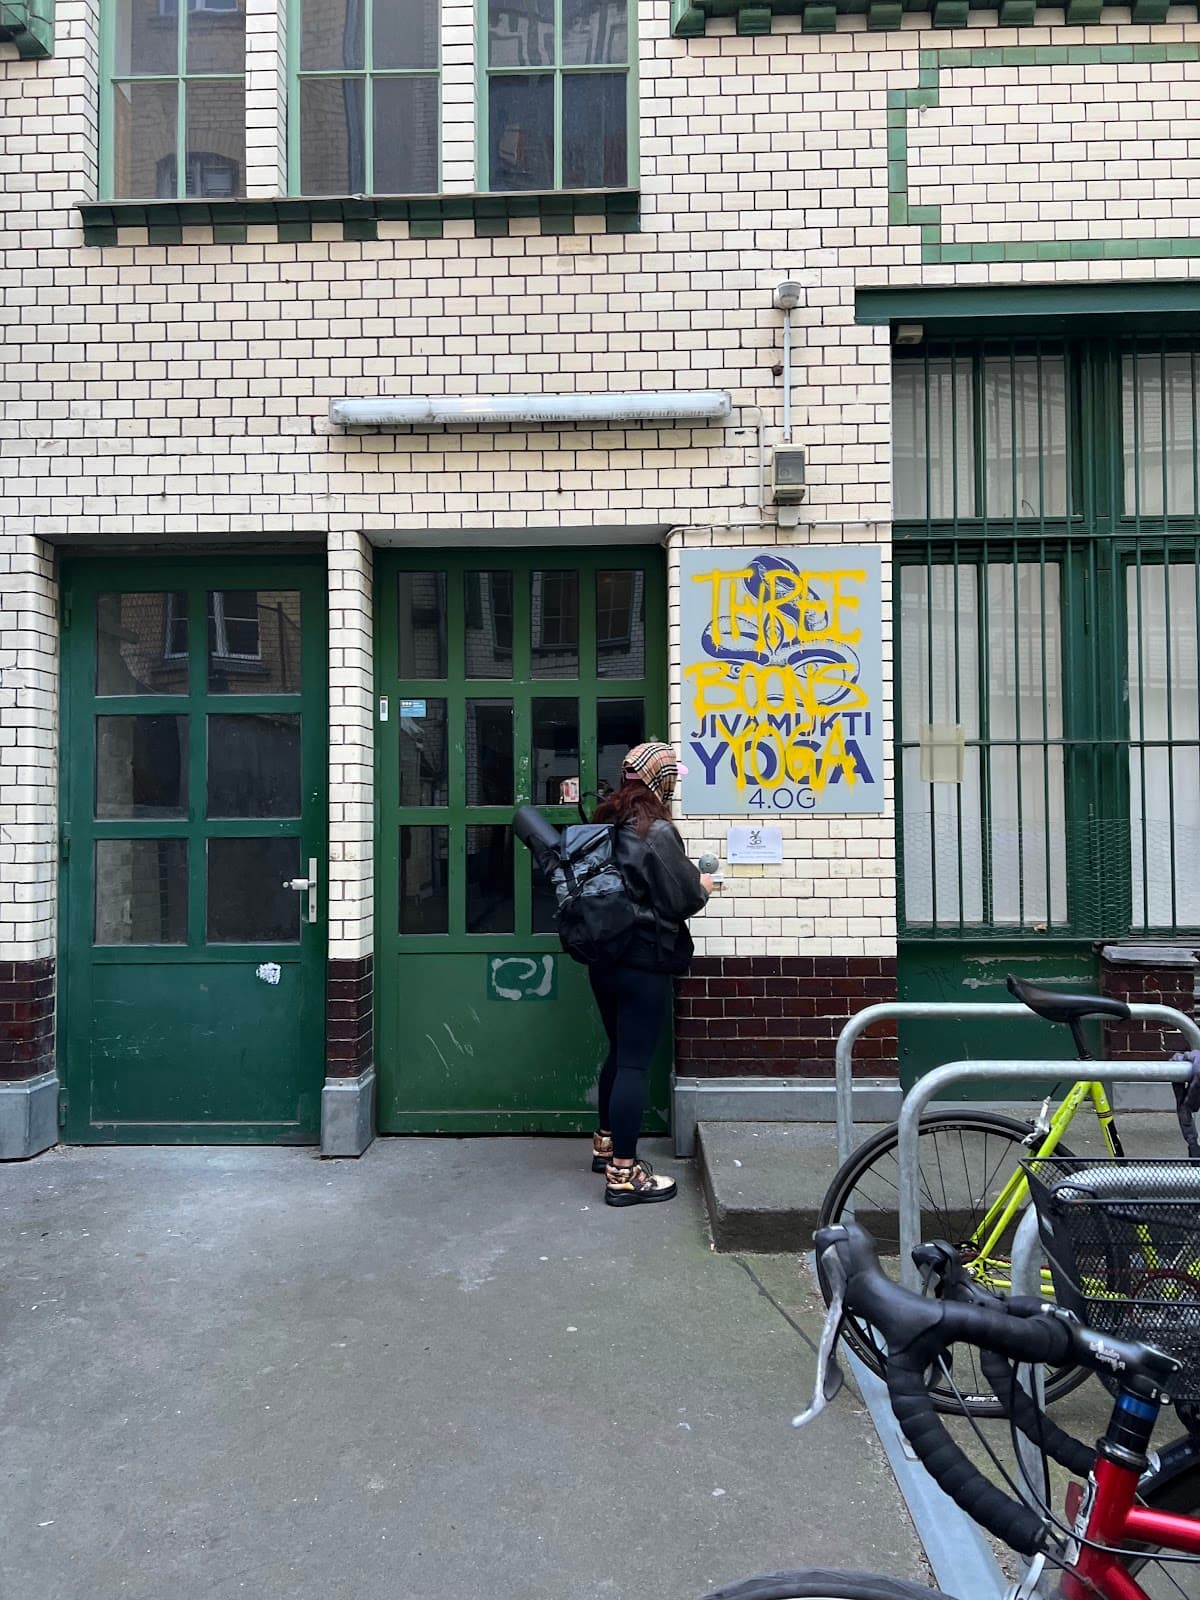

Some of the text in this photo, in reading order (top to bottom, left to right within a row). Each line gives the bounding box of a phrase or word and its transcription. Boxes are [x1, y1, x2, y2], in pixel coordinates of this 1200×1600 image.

[691, 568, 867, 653] THREE
[684, 661, 869, 717] BOONS
[689, 739, 875, 786] YOGA
[715, 719, 857, 792] YOGA
[748, 787, 816, 809] 4.OG
